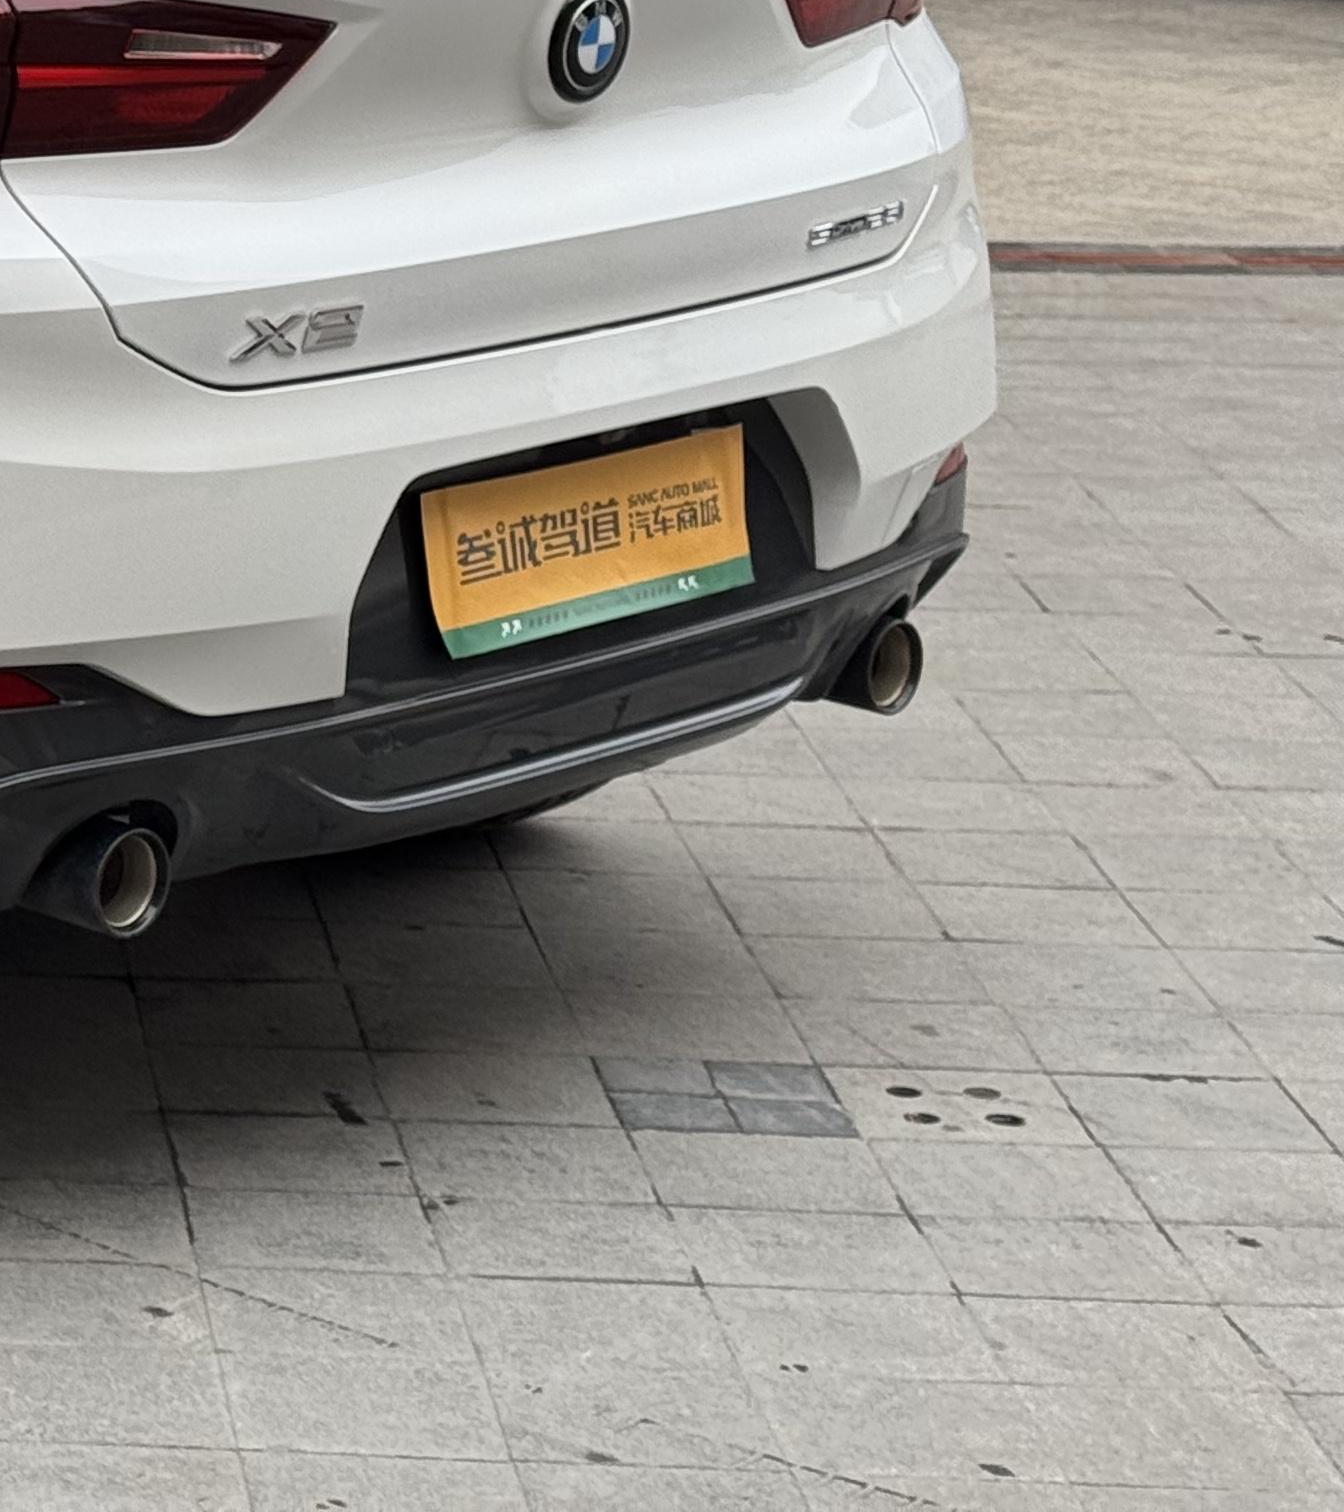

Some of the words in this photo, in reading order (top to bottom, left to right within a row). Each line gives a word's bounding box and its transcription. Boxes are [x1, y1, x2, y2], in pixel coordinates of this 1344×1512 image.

[661, 483, 689, 502] AUTO
[456, 498, 621, 586] 叁诚驾道
[628, 494, 723, 544] 汽车商城
